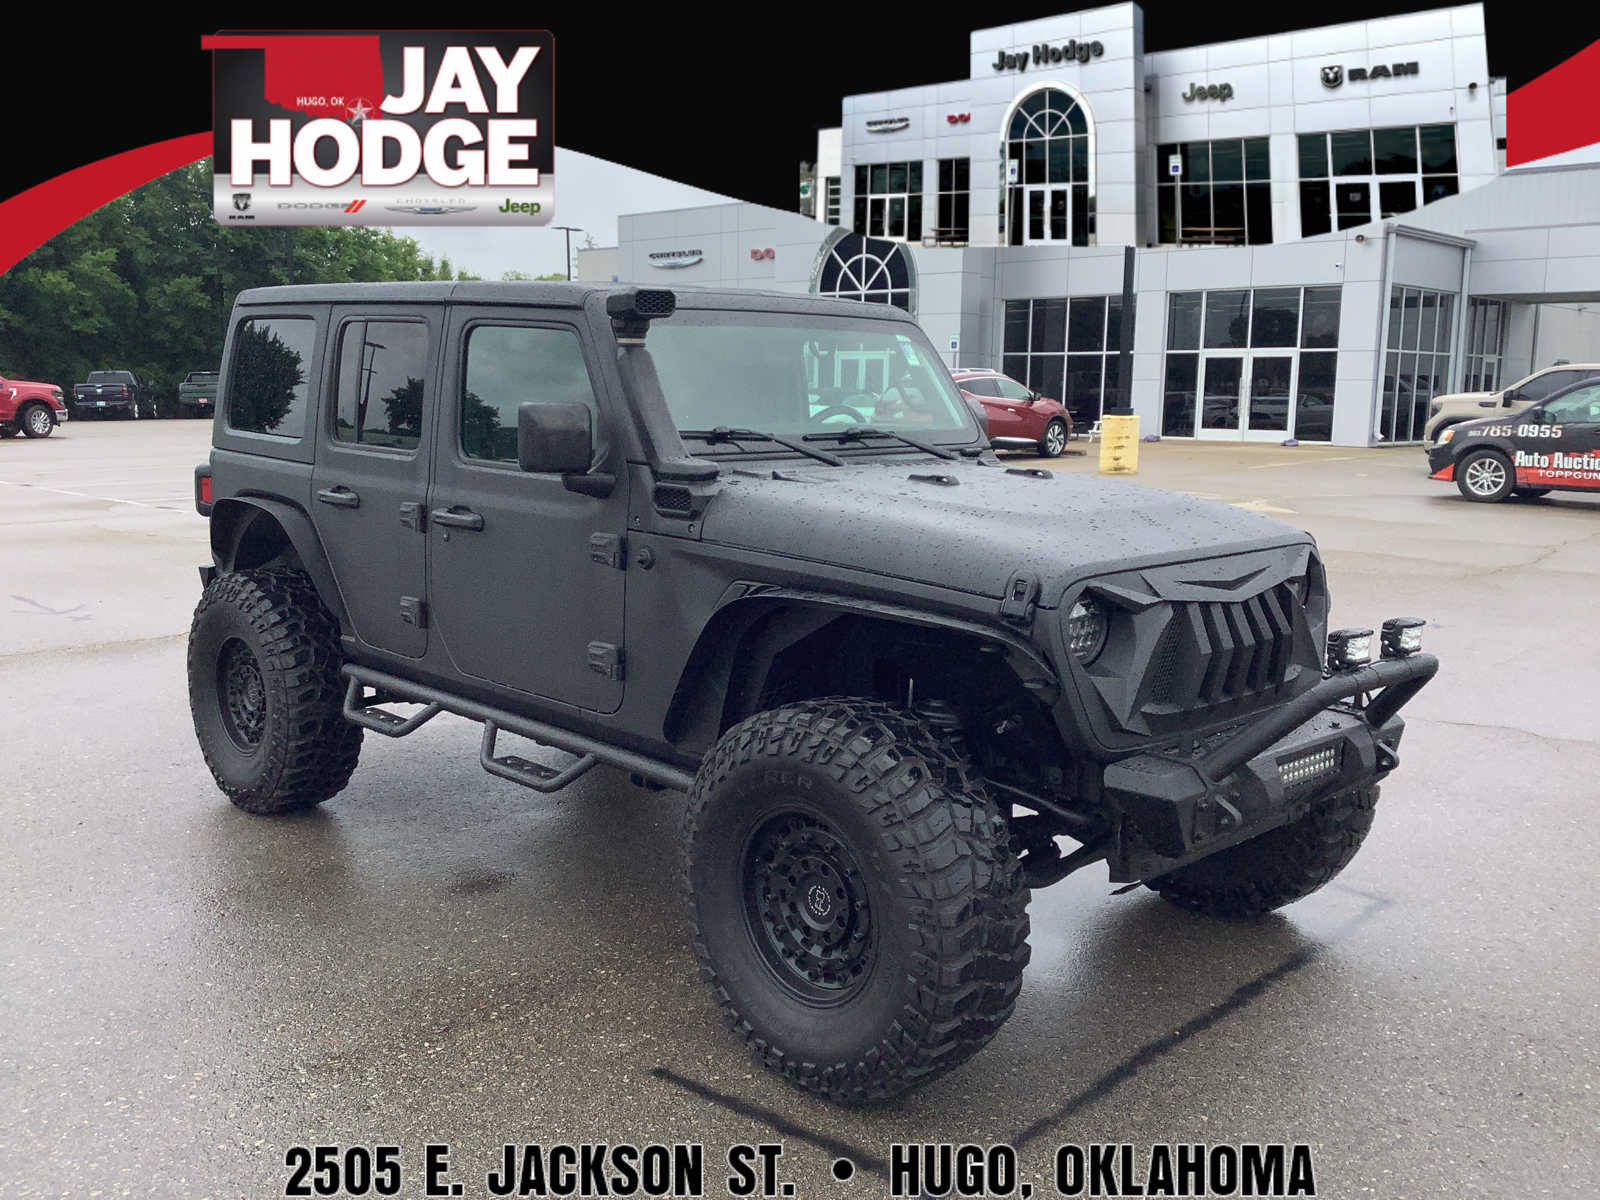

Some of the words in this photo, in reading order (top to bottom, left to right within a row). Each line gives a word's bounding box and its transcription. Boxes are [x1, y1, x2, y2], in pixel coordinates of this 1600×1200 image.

[992, 50, 1030, 73] Jay
[1032, 39, 1104, 64] Hodge
[1348, 61, 1419, 82] RAM
[1182, 82, 1234, 102] Jeep
[1514, 450, 1550, 468] Auto
